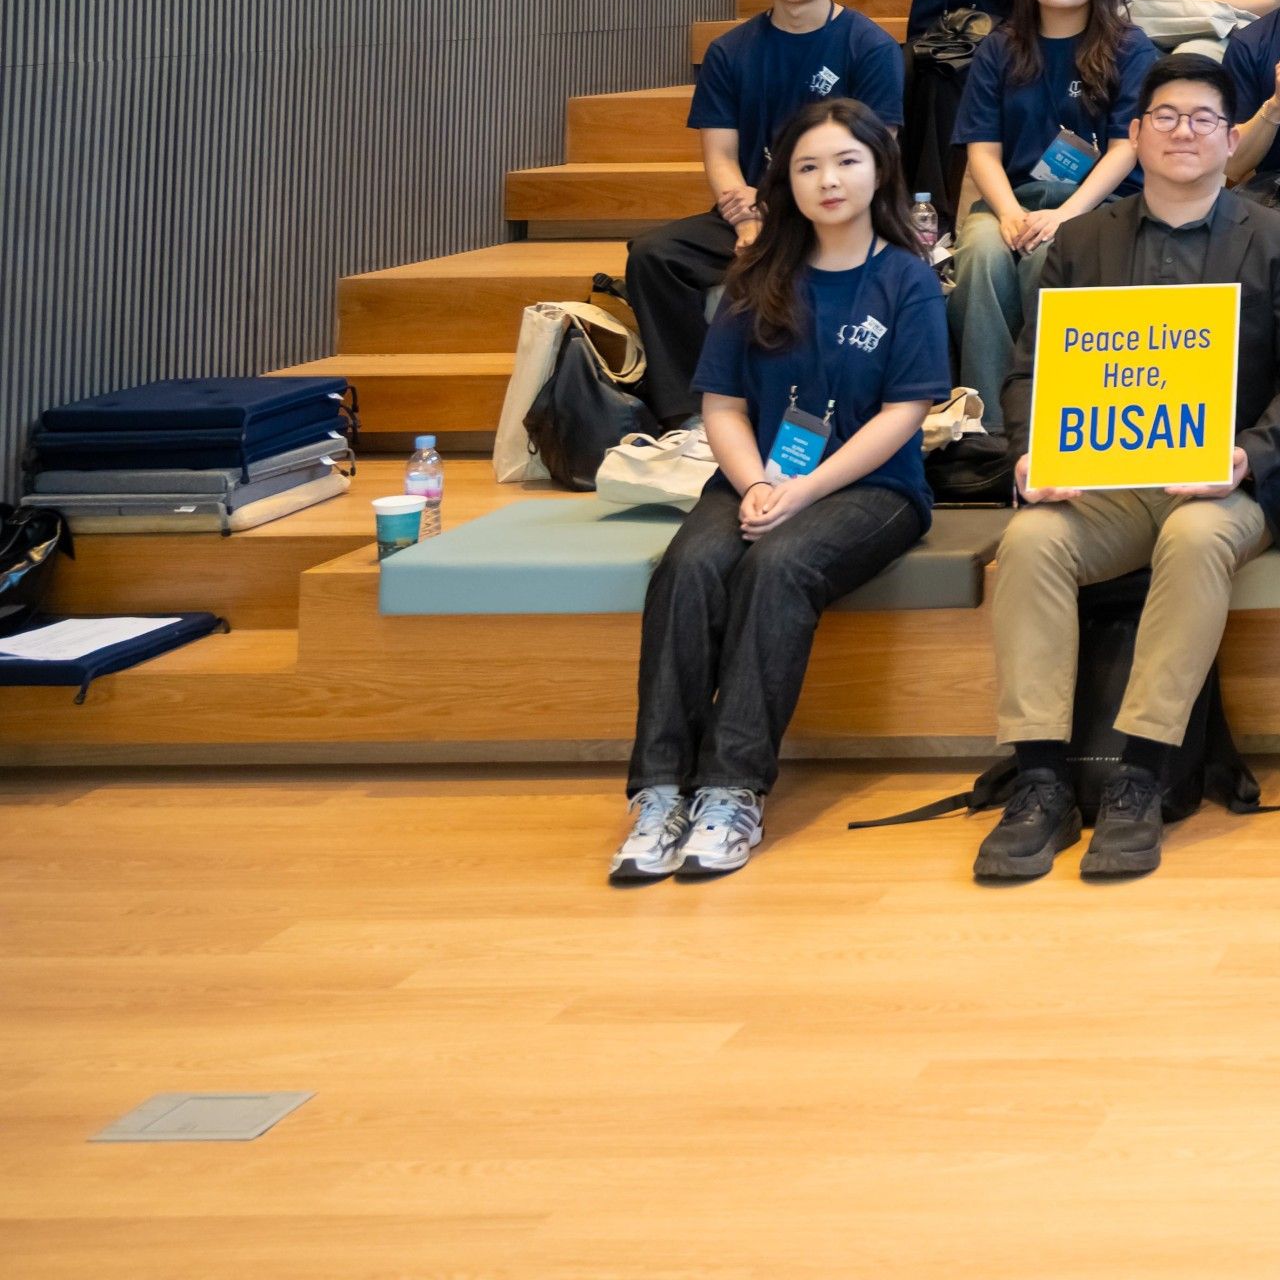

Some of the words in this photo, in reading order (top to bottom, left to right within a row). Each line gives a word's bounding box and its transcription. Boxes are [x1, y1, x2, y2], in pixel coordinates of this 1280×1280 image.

[1065, 328, 1139, 352] Peace
[1149, 324, 1211, 350] Lives
[1104, 363, 1166, 389] Here,
[1059, 403, 1205, 452] BUSAN
